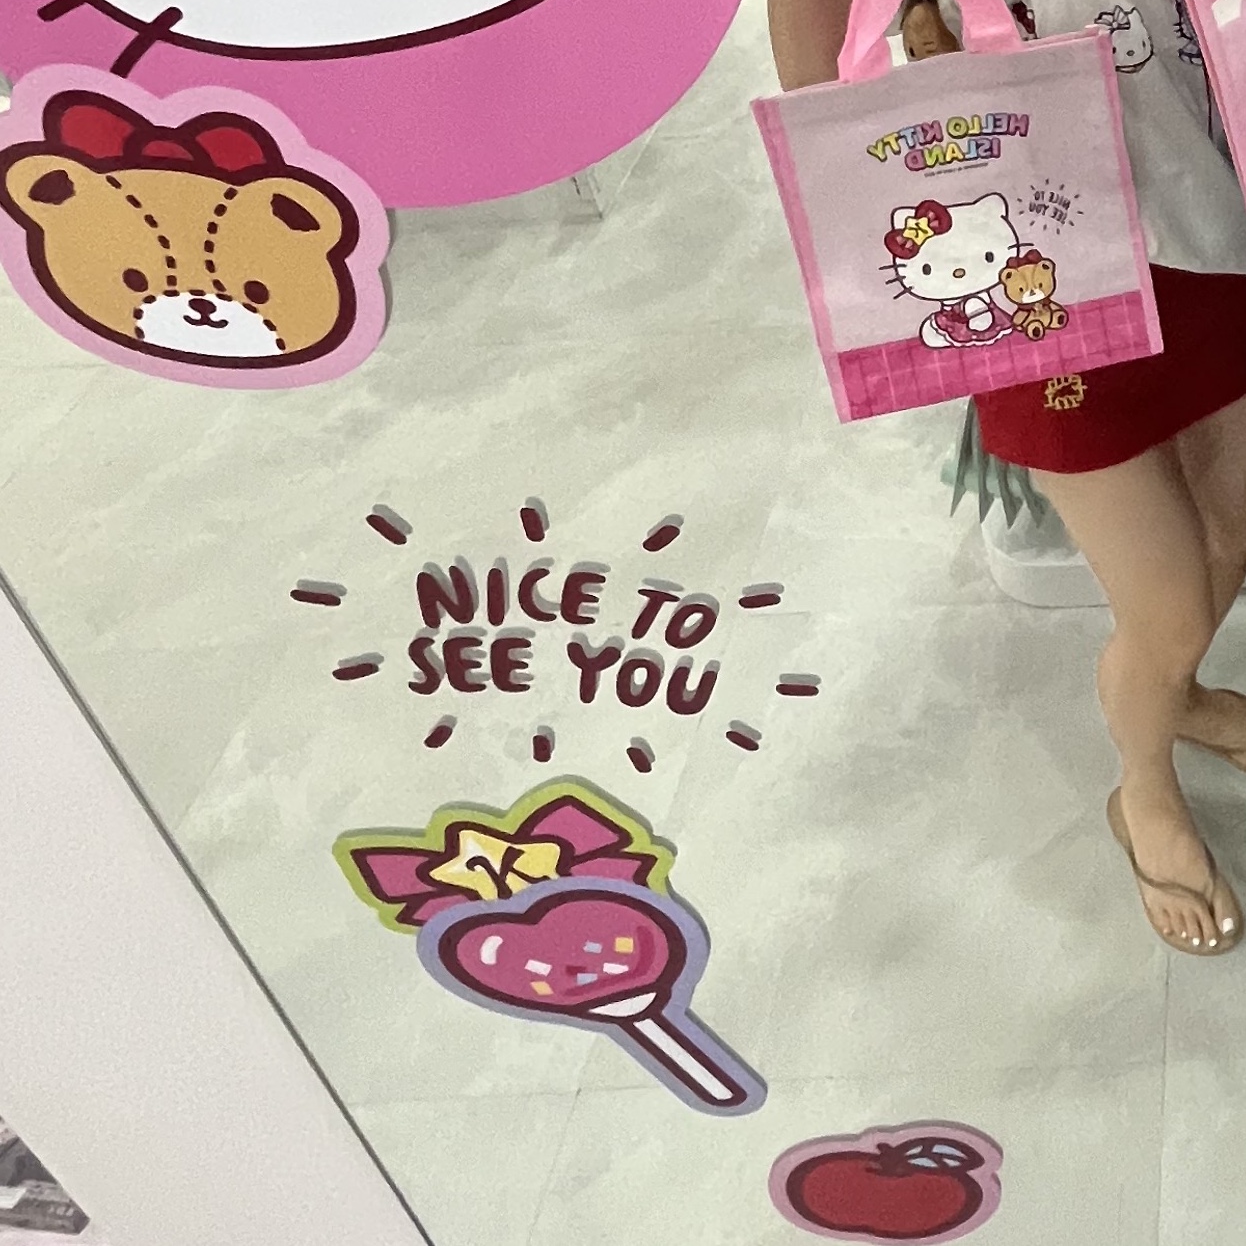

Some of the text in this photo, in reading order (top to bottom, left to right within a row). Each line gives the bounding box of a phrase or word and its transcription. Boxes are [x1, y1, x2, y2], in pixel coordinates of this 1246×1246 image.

[416, 565, 718, 649] NICE TO
[408, 636, 718, 715] SEE YOU
